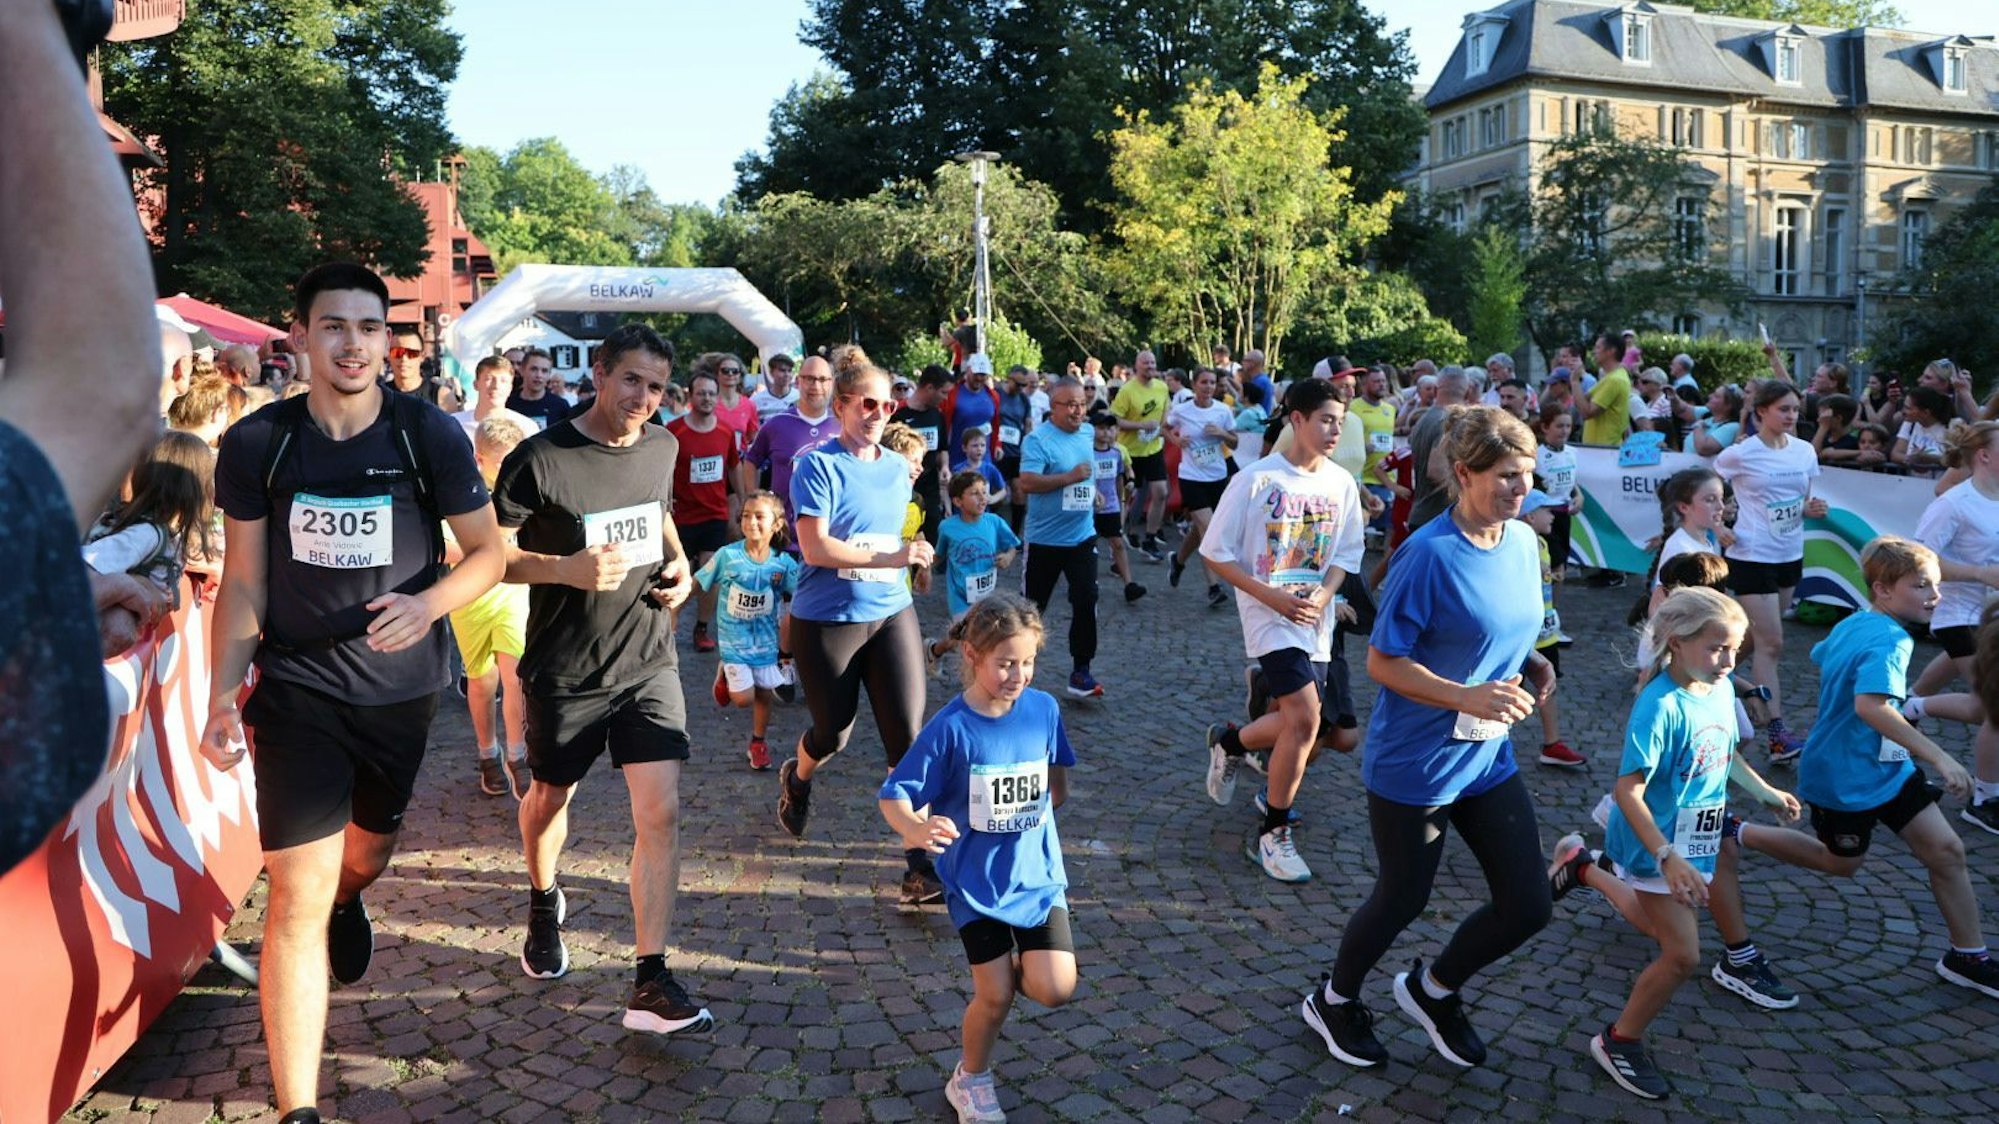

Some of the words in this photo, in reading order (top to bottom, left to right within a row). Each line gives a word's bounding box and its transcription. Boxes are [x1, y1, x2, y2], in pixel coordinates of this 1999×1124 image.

[590, 284, 654, 298] BELKAW
[698, 461, 717, 473] 1337
[1622, 475, 1663, 494] BEL
[302, 509, 377, 537] 2305
[604, 516, 649, 543] 1326
[309, 550, 372, 567] BELKAW
[738, 593, 766, 608] 1394
[991, 773, 1041, 805] 1368
[1688, 843, 1717, 856] BELK
